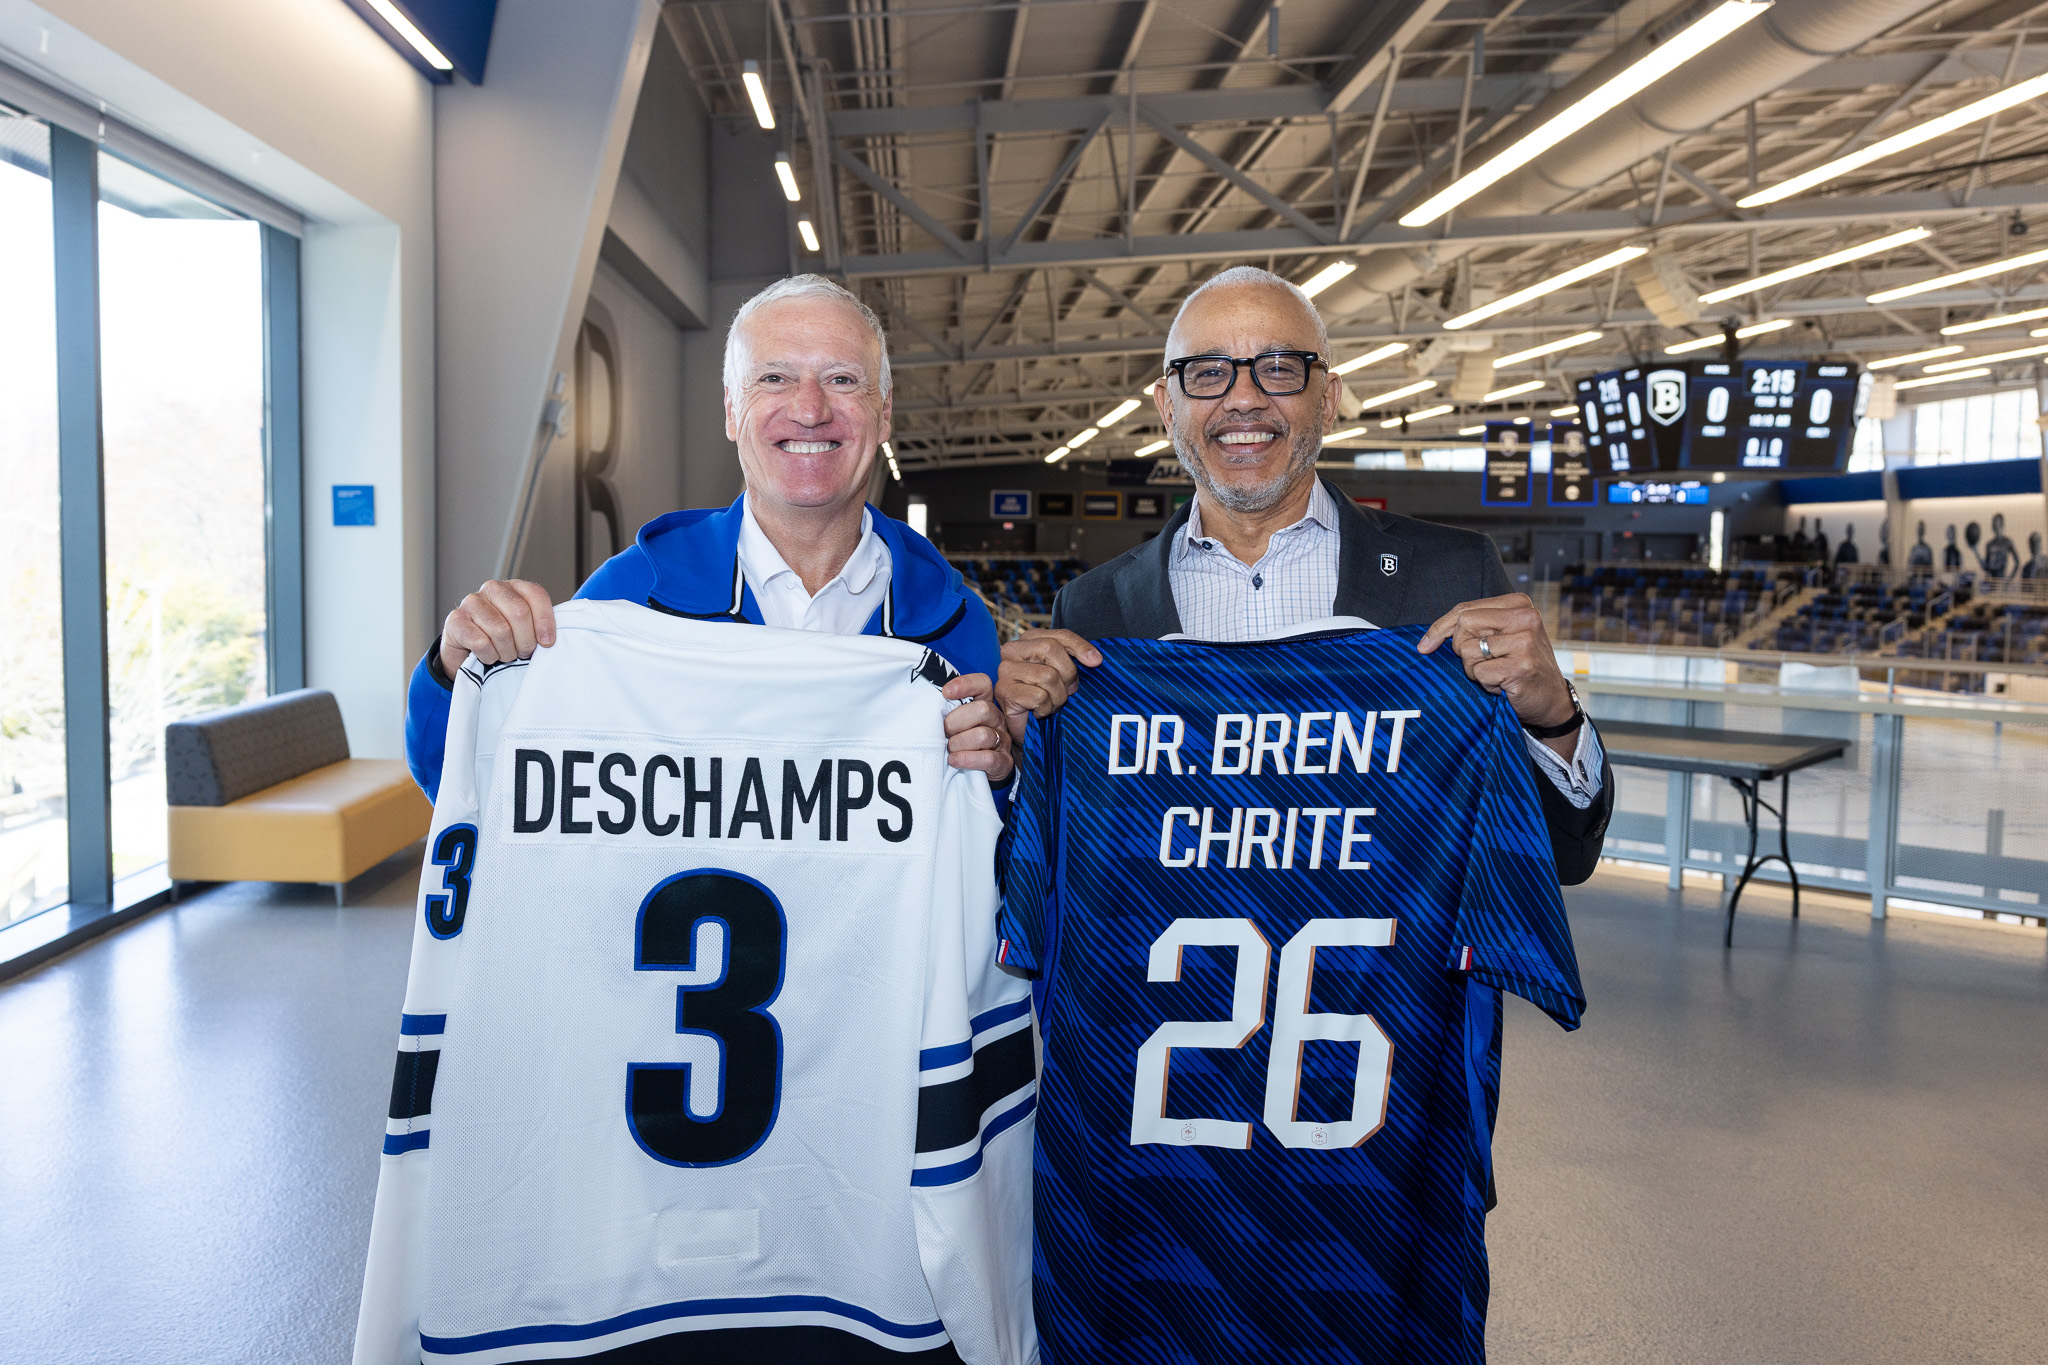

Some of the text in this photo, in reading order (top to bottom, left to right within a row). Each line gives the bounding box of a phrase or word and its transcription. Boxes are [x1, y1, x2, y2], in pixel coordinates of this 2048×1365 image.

[1653, 381, 1681, 414] B
[1707, 387, 1729, 423] 0
[1751, 368, 1796, 394] 2:15
[1809, 388, 1833, 424] 0
[1383, 558, 1395, 571] B
[1108, 710, 1421, 775] DR. BRENT
[513, 749, 912, 842] DESCHAMPS
[1159, 806, 1377, 870] CHRITE
[425, 823, 478, 940] 3
[625, 867, 788, 1168] 3
[1130, 918, 1397, 1150] 26
